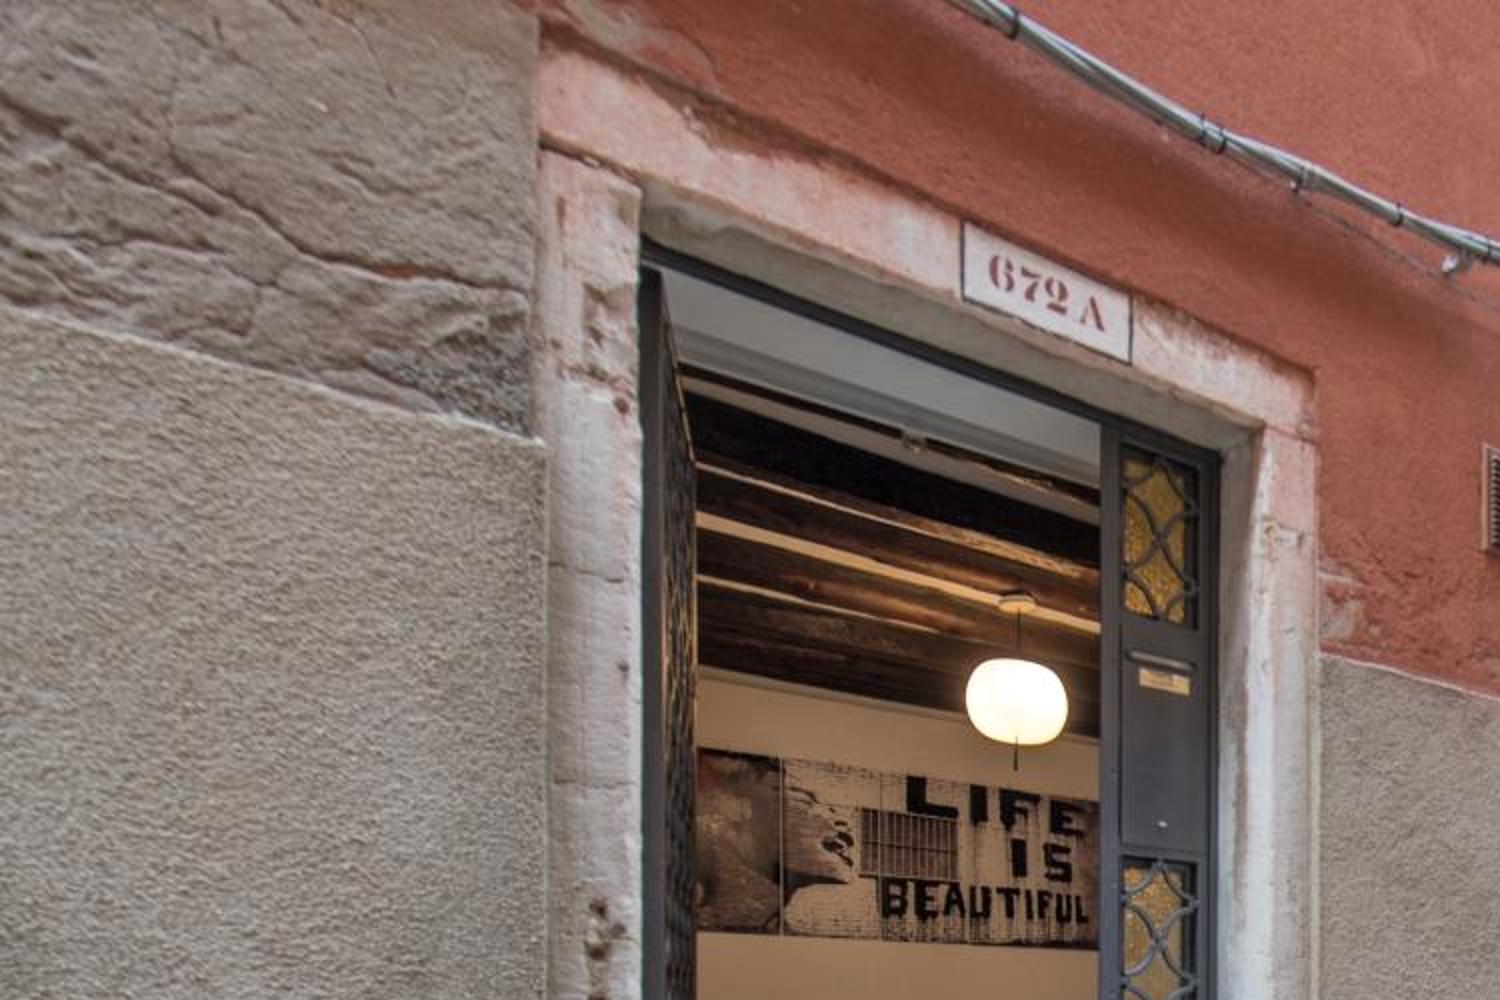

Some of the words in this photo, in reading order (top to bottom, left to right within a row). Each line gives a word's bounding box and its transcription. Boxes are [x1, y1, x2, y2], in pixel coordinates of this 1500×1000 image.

[906, 776, 1086, 838] LIFE
[1010, 838, 1073, 883] IS
[881, 879, 1089, 925] BEAUTIFUL
